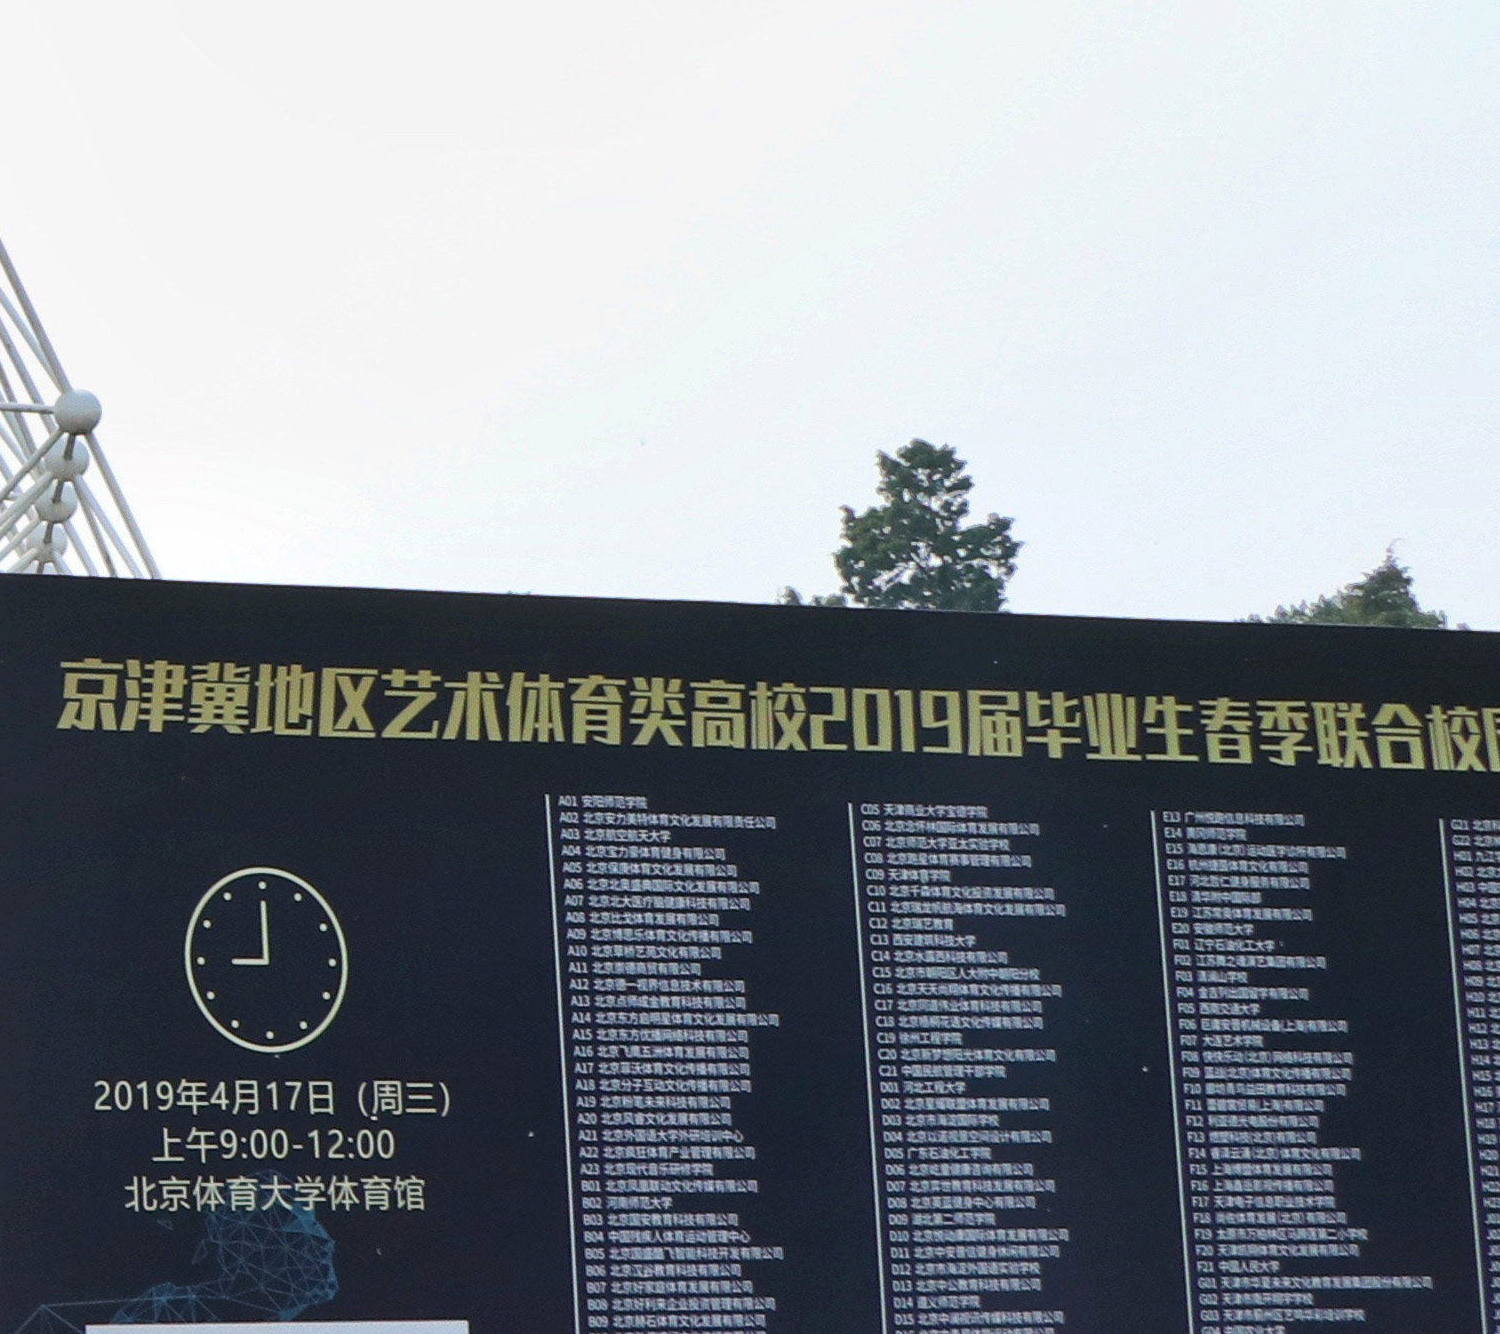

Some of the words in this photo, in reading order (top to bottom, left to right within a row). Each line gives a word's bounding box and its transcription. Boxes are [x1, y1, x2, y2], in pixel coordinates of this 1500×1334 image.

[56, 657, 1500, 773] 京津冀地区艺术体育类高校2019届毕业生春季联合校
[152, 1127, 396, 1164] 上午9:00-12:00
[123, 1175, 426, 1213] 北京体育大学体育馆
